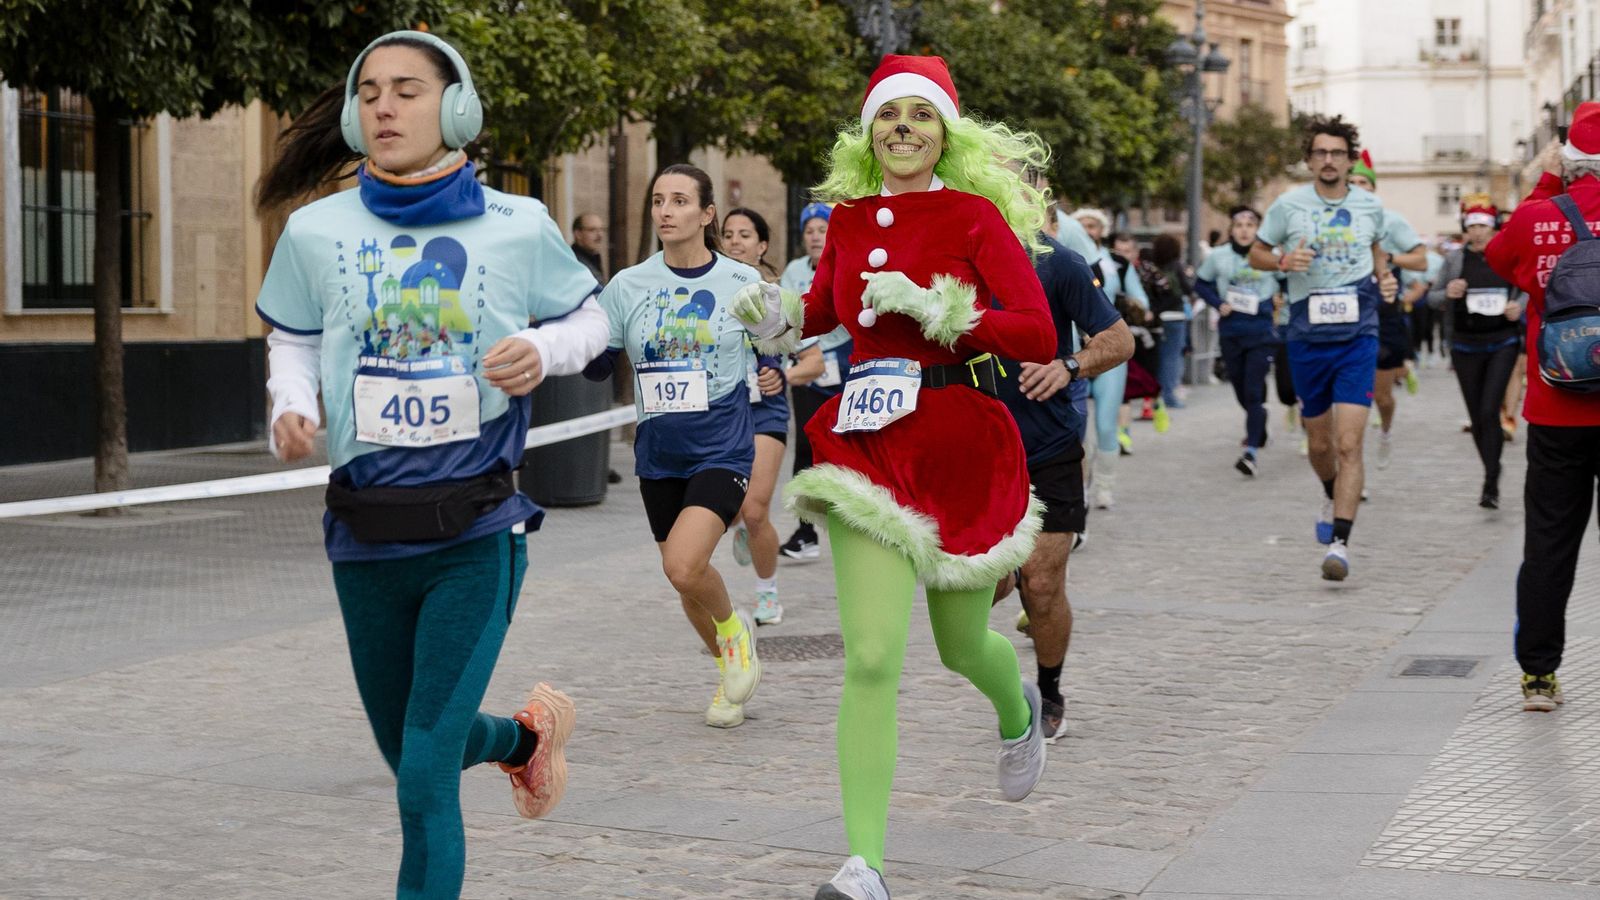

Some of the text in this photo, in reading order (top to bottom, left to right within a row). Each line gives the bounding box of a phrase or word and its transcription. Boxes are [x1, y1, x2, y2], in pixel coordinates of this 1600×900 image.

[1534, 222, 1559, 232] SAN
[1537, 255, 1562, 270] FO
[1320, 303, 1347, 315] 609
[655, 382, 689, 401] 197
[380, 394, 451, 427] 405
[847, 387, 904, 417] 1460
